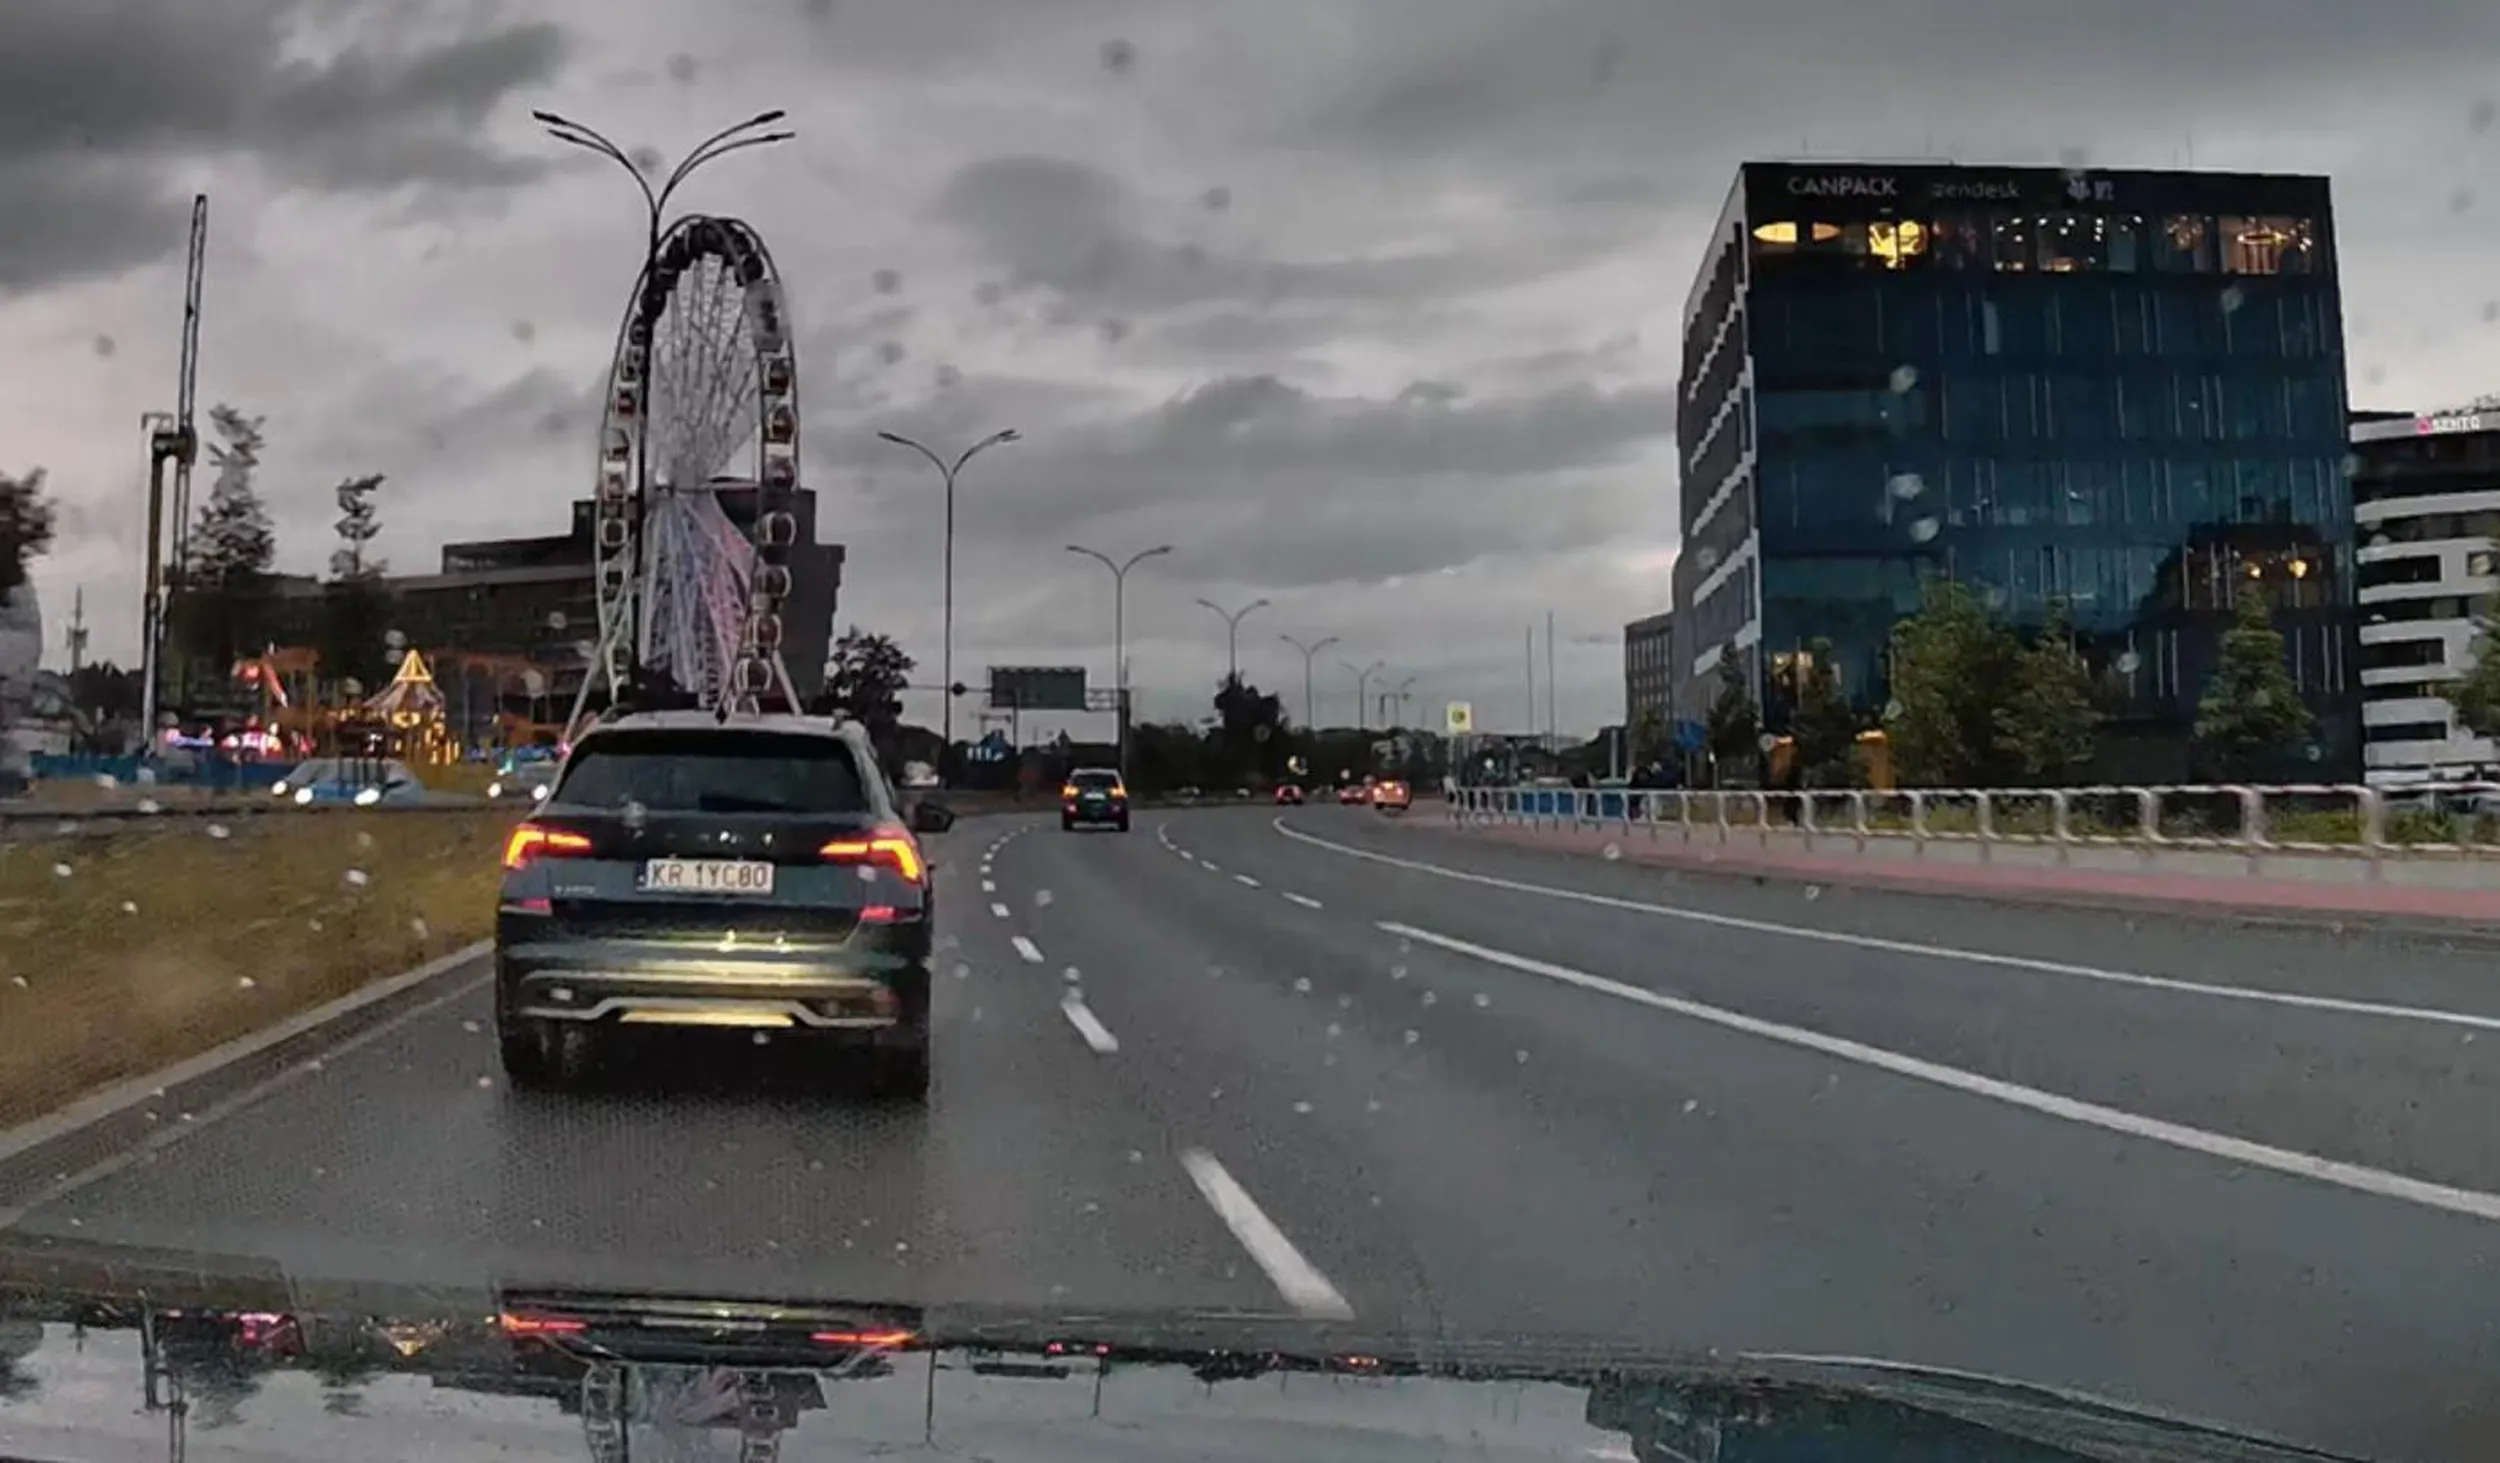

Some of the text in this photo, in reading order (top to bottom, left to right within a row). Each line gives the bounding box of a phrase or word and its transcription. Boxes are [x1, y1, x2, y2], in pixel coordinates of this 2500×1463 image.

[1786, 176, 1898, 197] CANPACK
[651, 863, 769, 888] KR 1YC80
